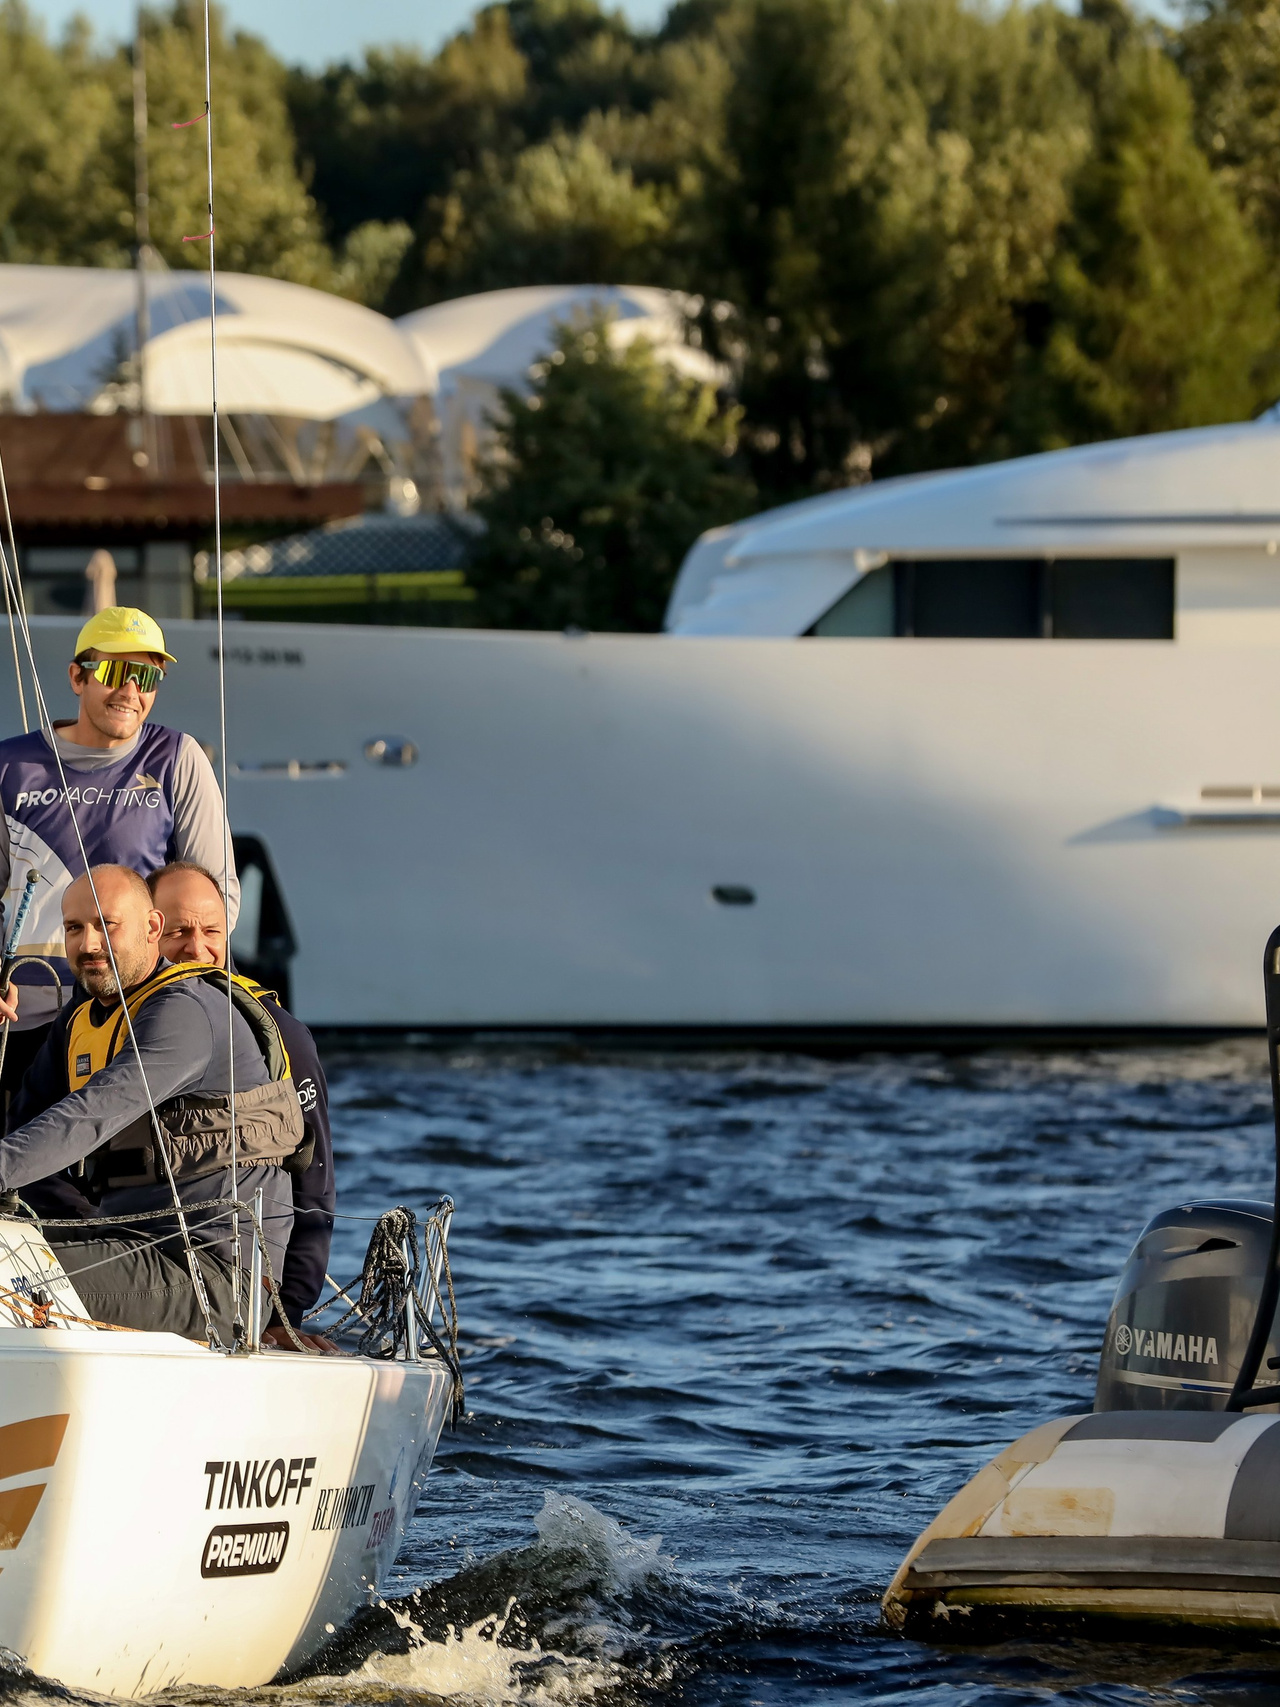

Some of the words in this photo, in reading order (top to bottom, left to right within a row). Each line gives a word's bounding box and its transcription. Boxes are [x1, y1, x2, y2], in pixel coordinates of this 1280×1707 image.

[15, 787, 161, 811] PROYACHTING
[1133, 1328, 1219, 1365] YAMAHA
[204, 1457, 317, 1511] TINKOFF
[205, 1531, 287, 1569] PREMIUM
